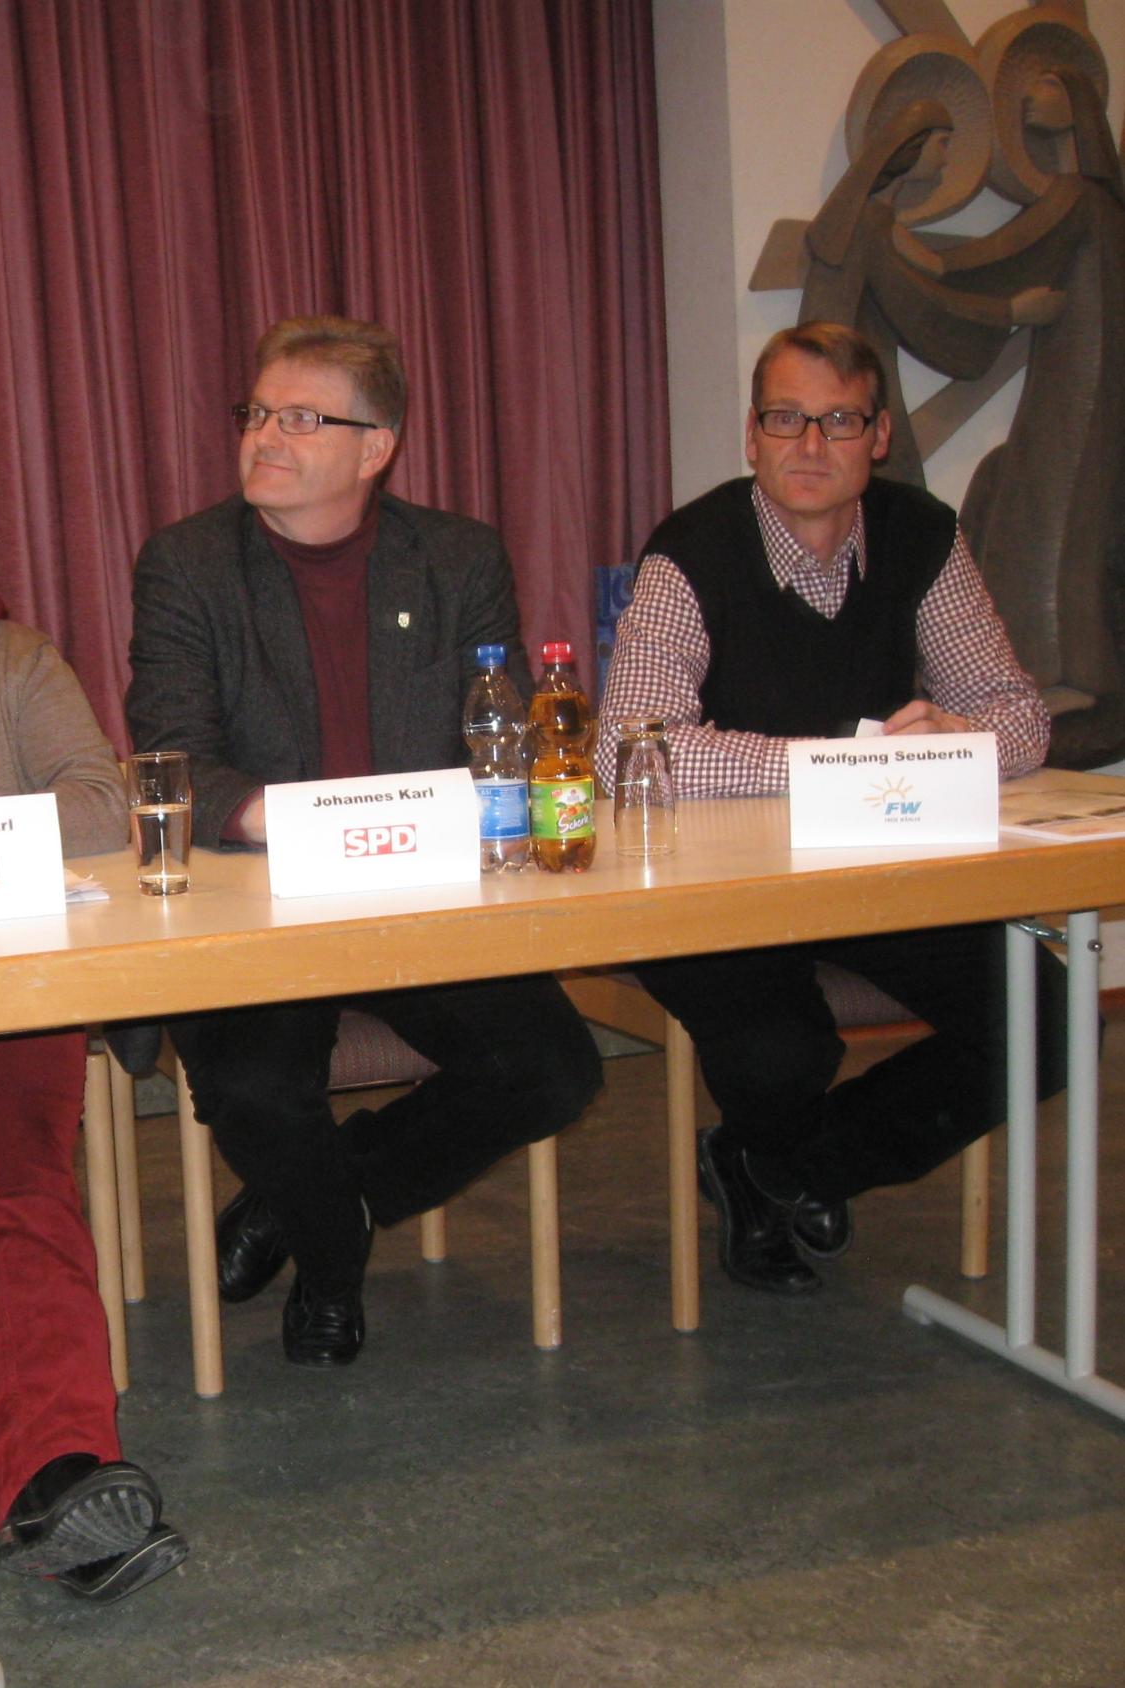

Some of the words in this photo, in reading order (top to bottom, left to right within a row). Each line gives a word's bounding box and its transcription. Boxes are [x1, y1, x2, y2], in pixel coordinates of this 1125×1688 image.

[809, 752, 889, 766] Wolfgang
[894, 748, 973, 762] Seuberth
[312, 792, 394, 807] Johannes
[398, 787, 434, 801] Karl
[884, 801, 922, 815] FW
[344, 824, 416, 857] SPD
